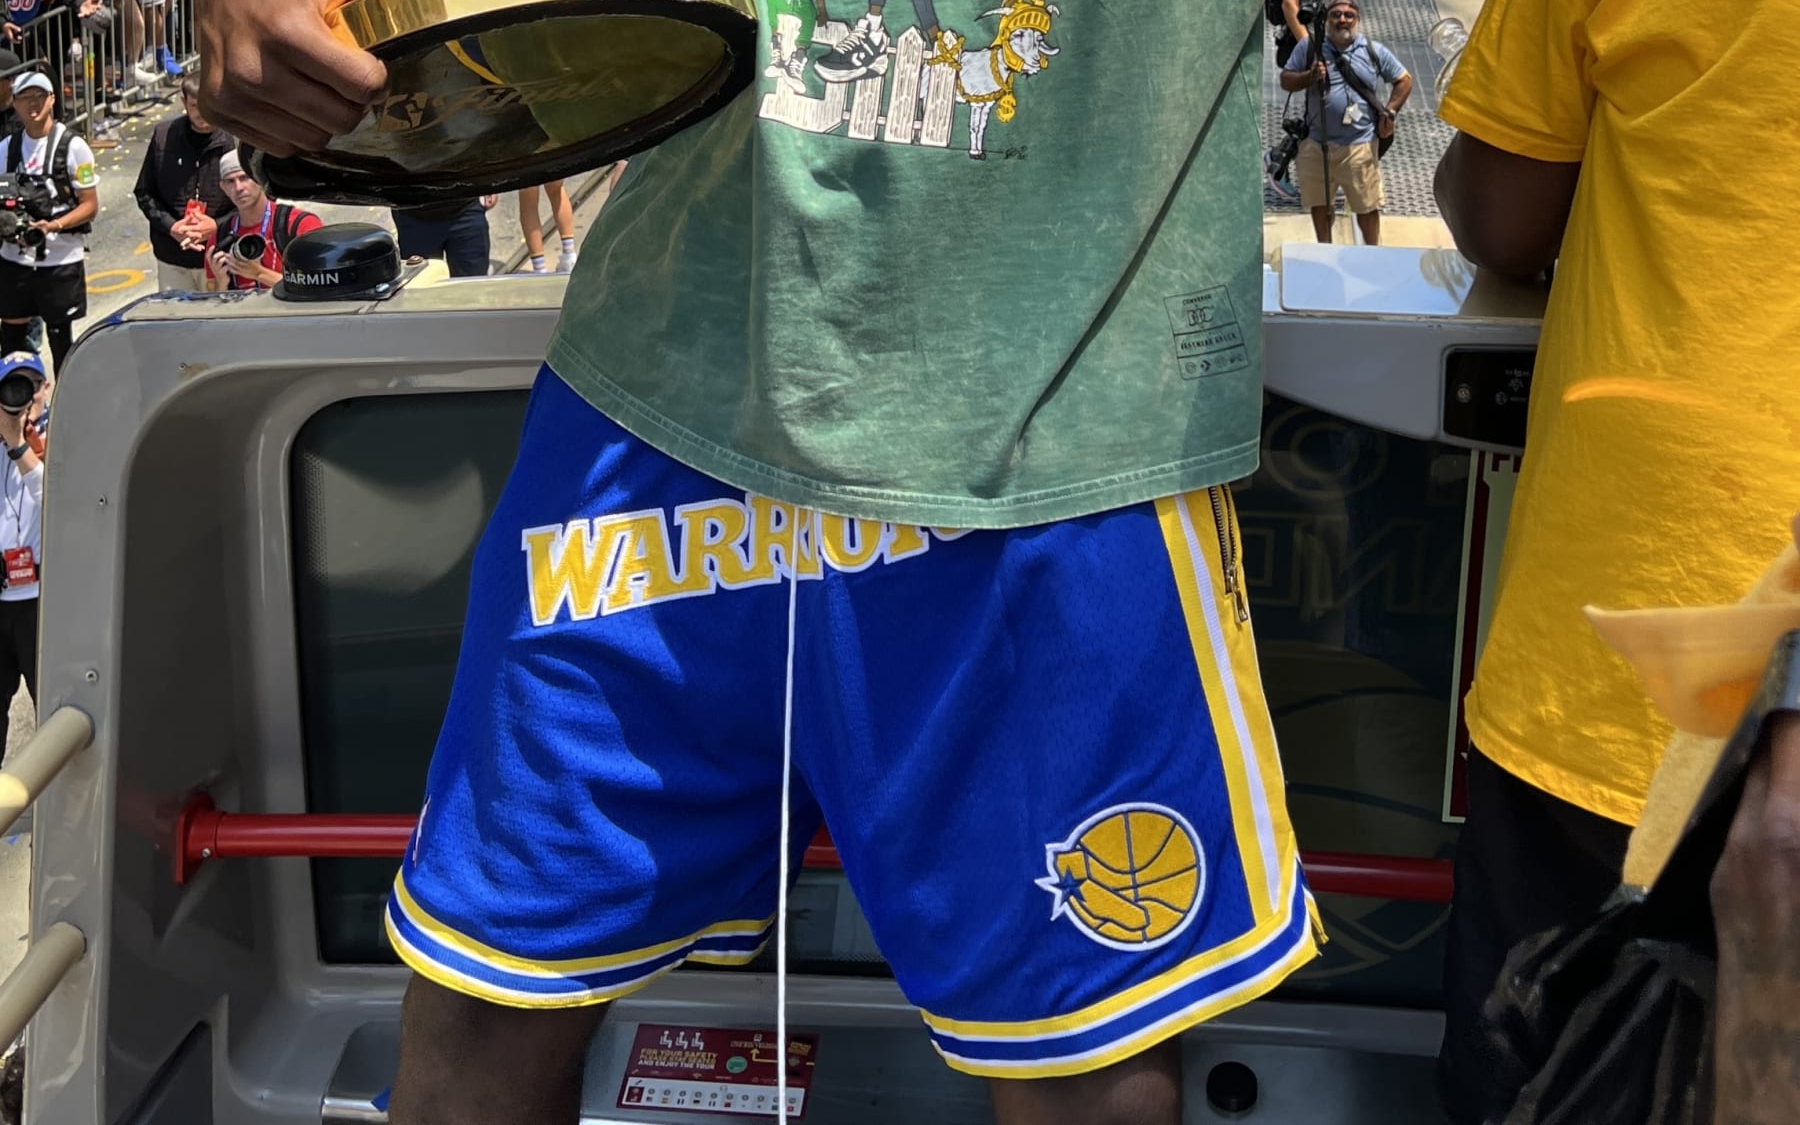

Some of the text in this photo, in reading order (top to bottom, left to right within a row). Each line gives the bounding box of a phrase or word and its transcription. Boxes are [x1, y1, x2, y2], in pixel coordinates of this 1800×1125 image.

[284, 271, 340, 286] GARMIN
[521, 492, 970, 627] WARRIO
[638, 1058, 654, 1066] AND
[655, 1060, 679, 1068] ENJOY
